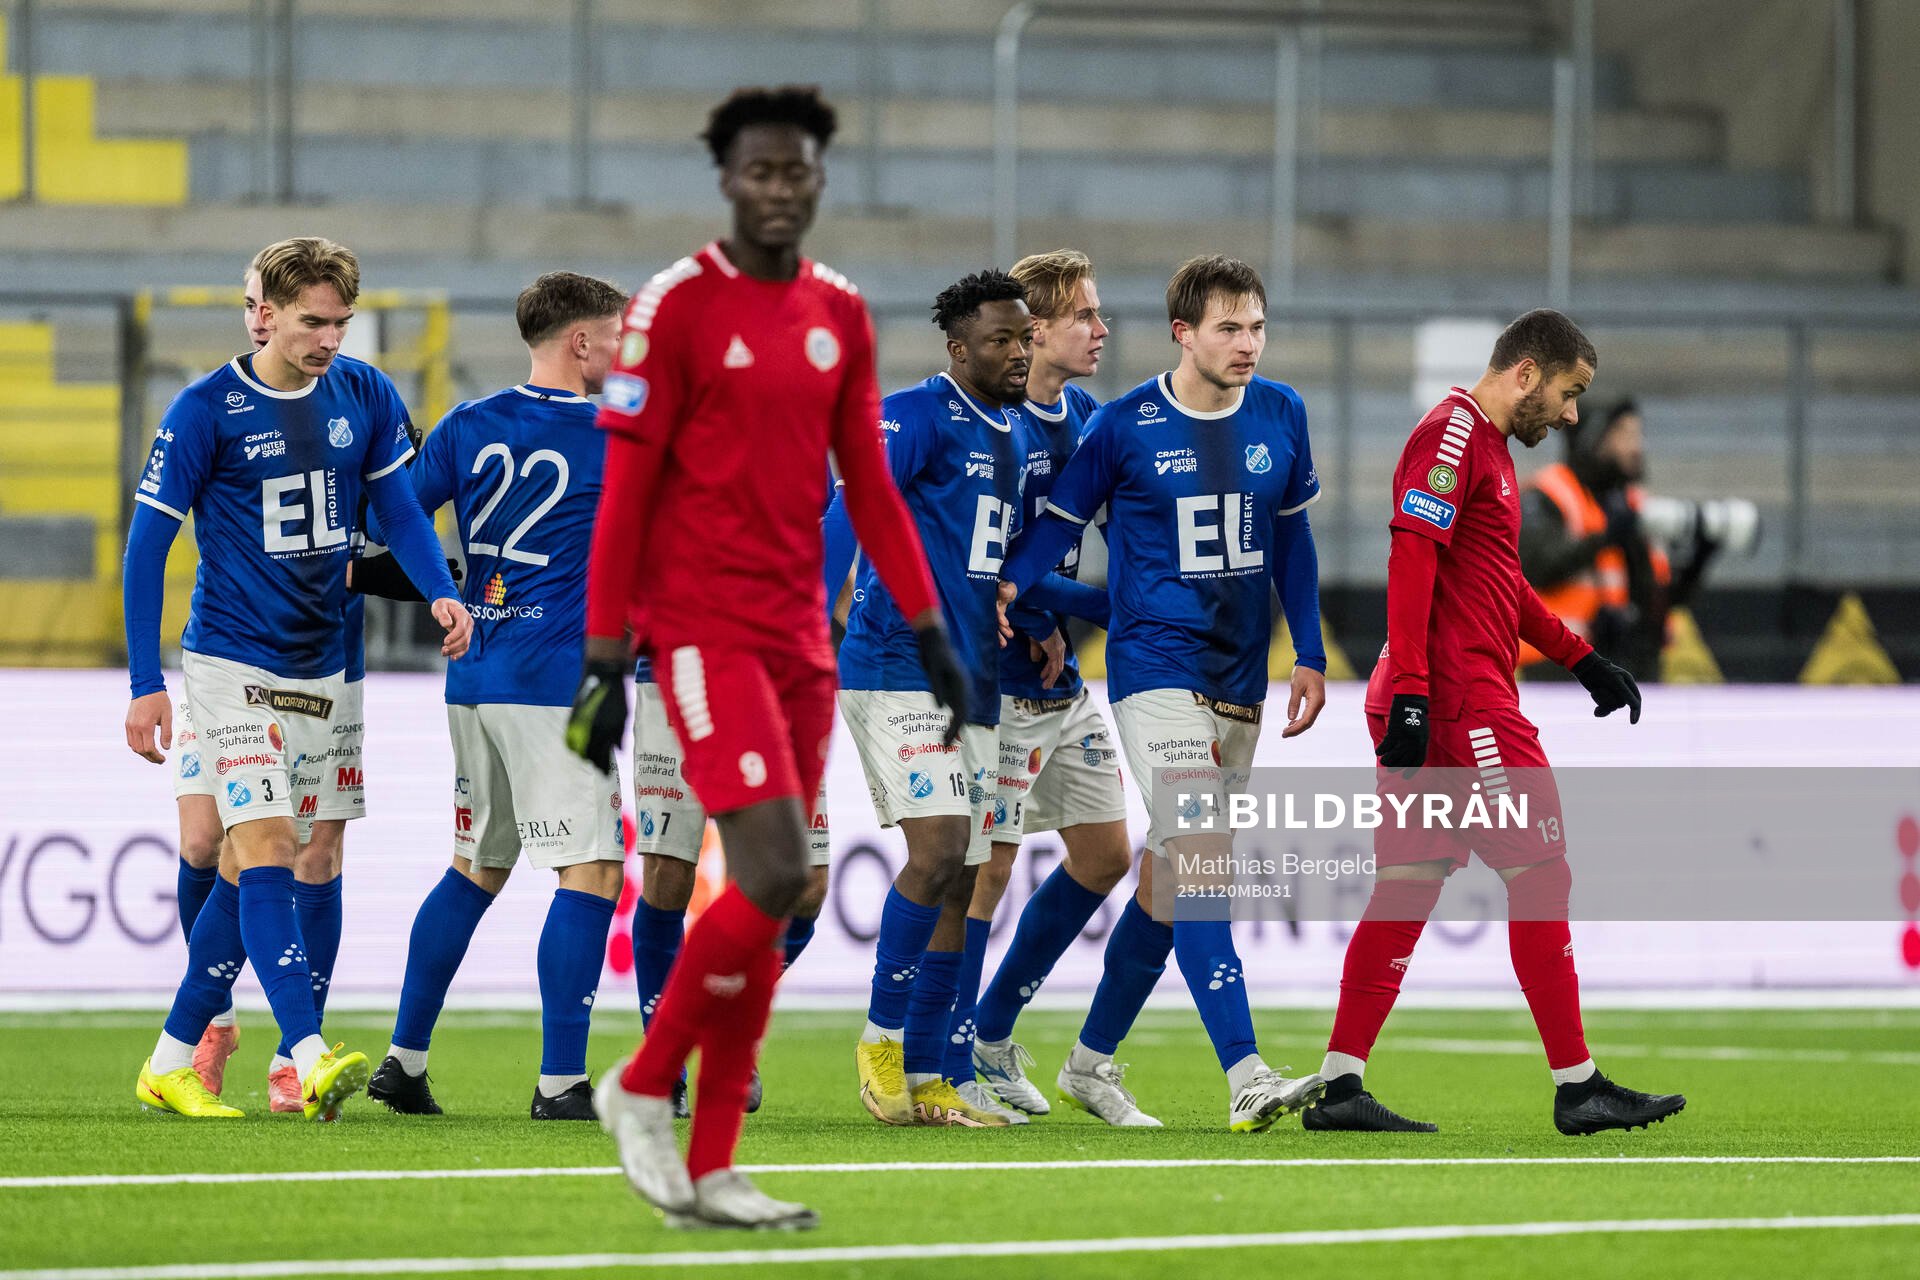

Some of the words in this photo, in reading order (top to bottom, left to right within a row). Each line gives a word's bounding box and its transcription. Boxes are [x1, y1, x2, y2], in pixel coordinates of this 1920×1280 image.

[245, 431, 274, 443] CRAFT
[260, 440, 286, 451] INTER
[261, 447, 287, 458] SPORT
[970, 452, 991, 462] CRAFT
[1156, 449, 1187, 459] CRAFT
[978, 462, 994, 473] INTER
[1031, 460, 1051, 469] INTER
[1171, 457, 1198, 467] INTER
[1172, 464, 1199, 474] SPORT
[1032, 467, 1052, 476] SPORT
[1438, 472, 1449, 486] S
[328, 467, 338, 528] PROJEKT.
[468, 443, 570, 567] 22
[263, 470, 348, 553] EL
[1409, 494, 1452, 519] UNIBET
[1242, 491, 1255, 550] PROJEKT.
[1176, 492, 1264, 573] EL
[206, 722, 264, 740] Sparbanken
[219, 734, 265, 749] Sjuhärad
[1147, 738, 1208, 753] Sparbanken
[328, 746, 355, 757] Brink
[1163, 750, 1209, 764] Sjuhärad
[738, 751, 768, 789] 9
[261, 779, 274, 803] 3
[949, 773, 966, 797] 16
[639, 784, 685, 802] askinhjälp
[1014, 802, 1022, 826] 5
[660, 812, 671, 836] 7
[1537, 816, 1561, 844] 13
[536, 841, 565, 849] SWEDEN
